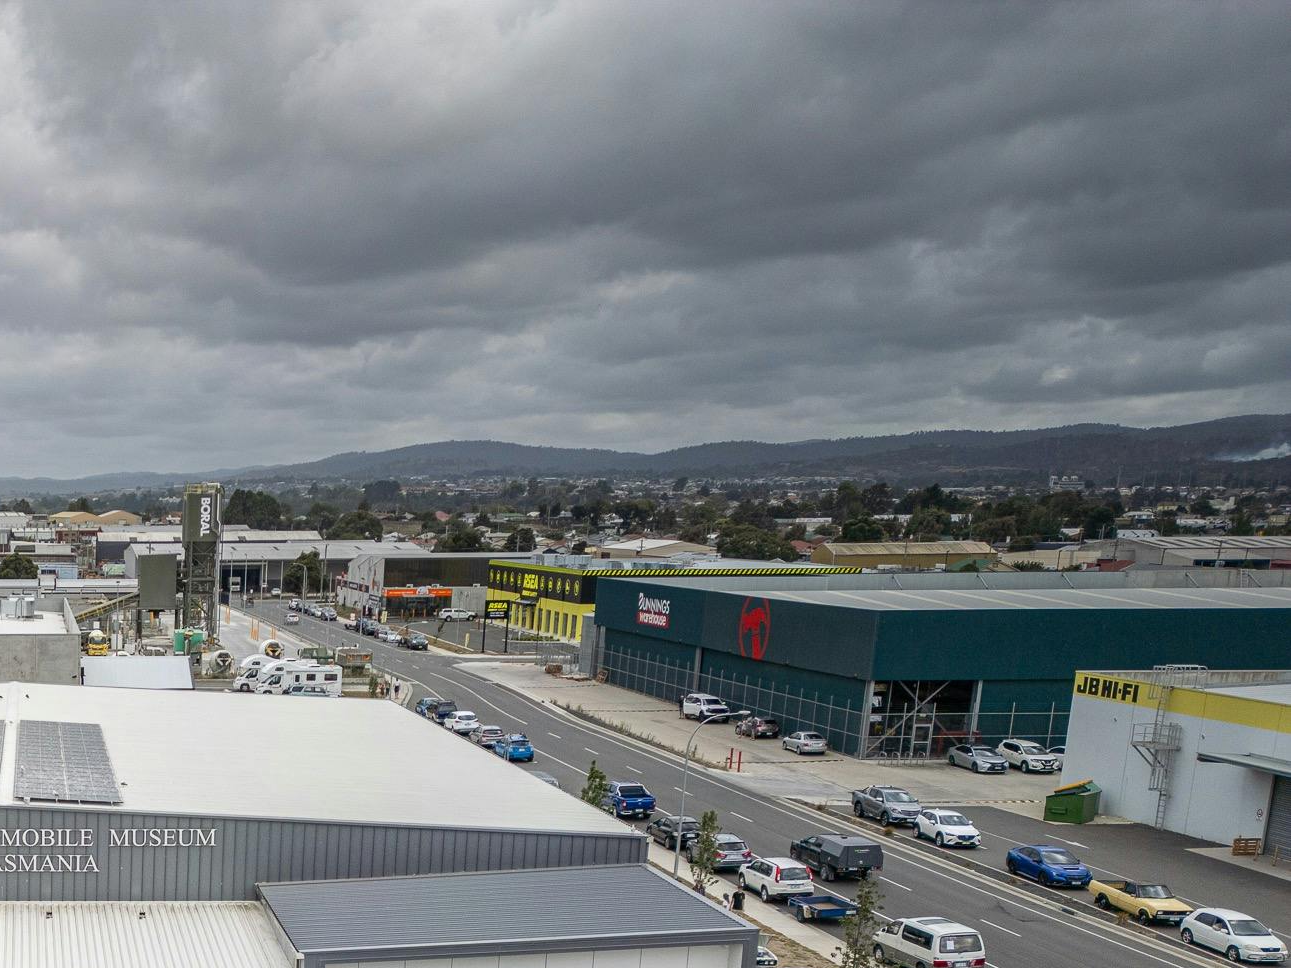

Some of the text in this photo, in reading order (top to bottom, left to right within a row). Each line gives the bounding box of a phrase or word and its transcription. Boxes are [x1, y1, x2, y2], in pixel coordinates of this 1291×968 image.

[200, 497, 211, 537] BORAL
[638, 592, 670, 615] BUNNINGS
[1077, 676, 1100, 696] JB
[109, 828, 217, 847] MUSEUM
